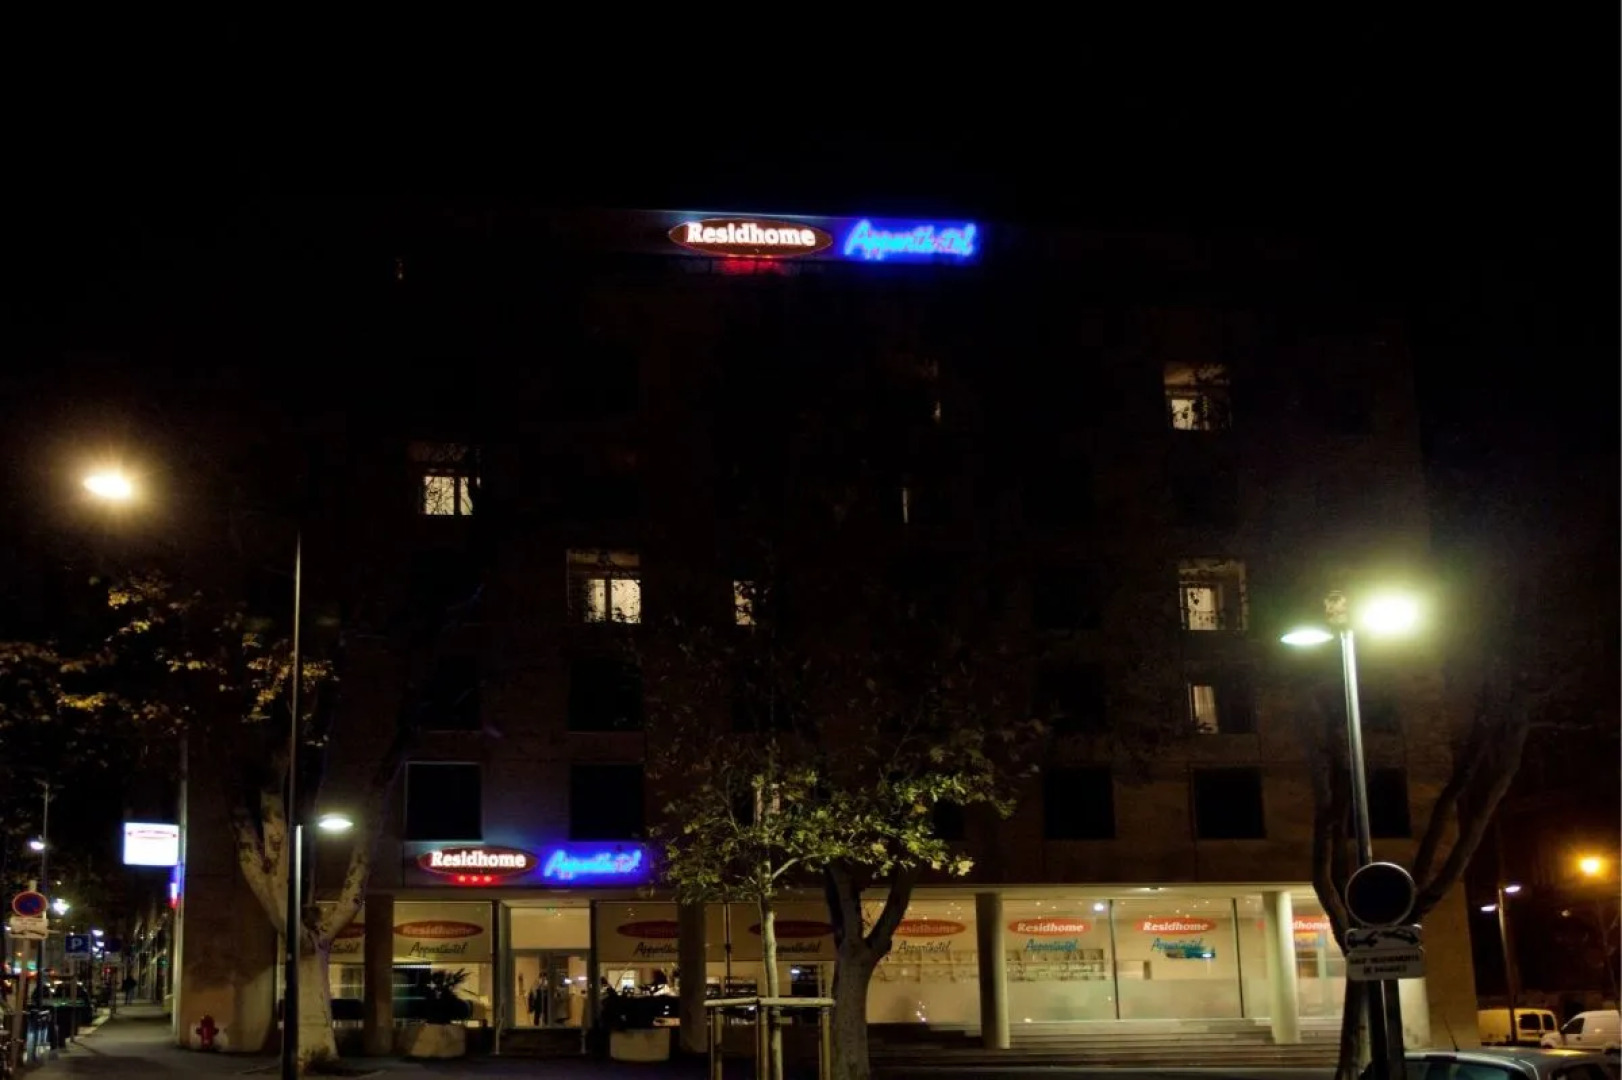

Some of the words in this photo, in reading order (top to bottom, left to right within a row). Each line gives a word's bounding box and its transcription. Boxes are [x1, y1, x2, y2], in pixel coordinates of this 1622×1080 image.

[685, 221, 816, 247] Residhome
[430, 850, 527, 868] Residhome
[1016, 921, 1084, 932] Residhome
[1142, 921, 1209, 932] Residhome
[71, 937, 82, 949] P
